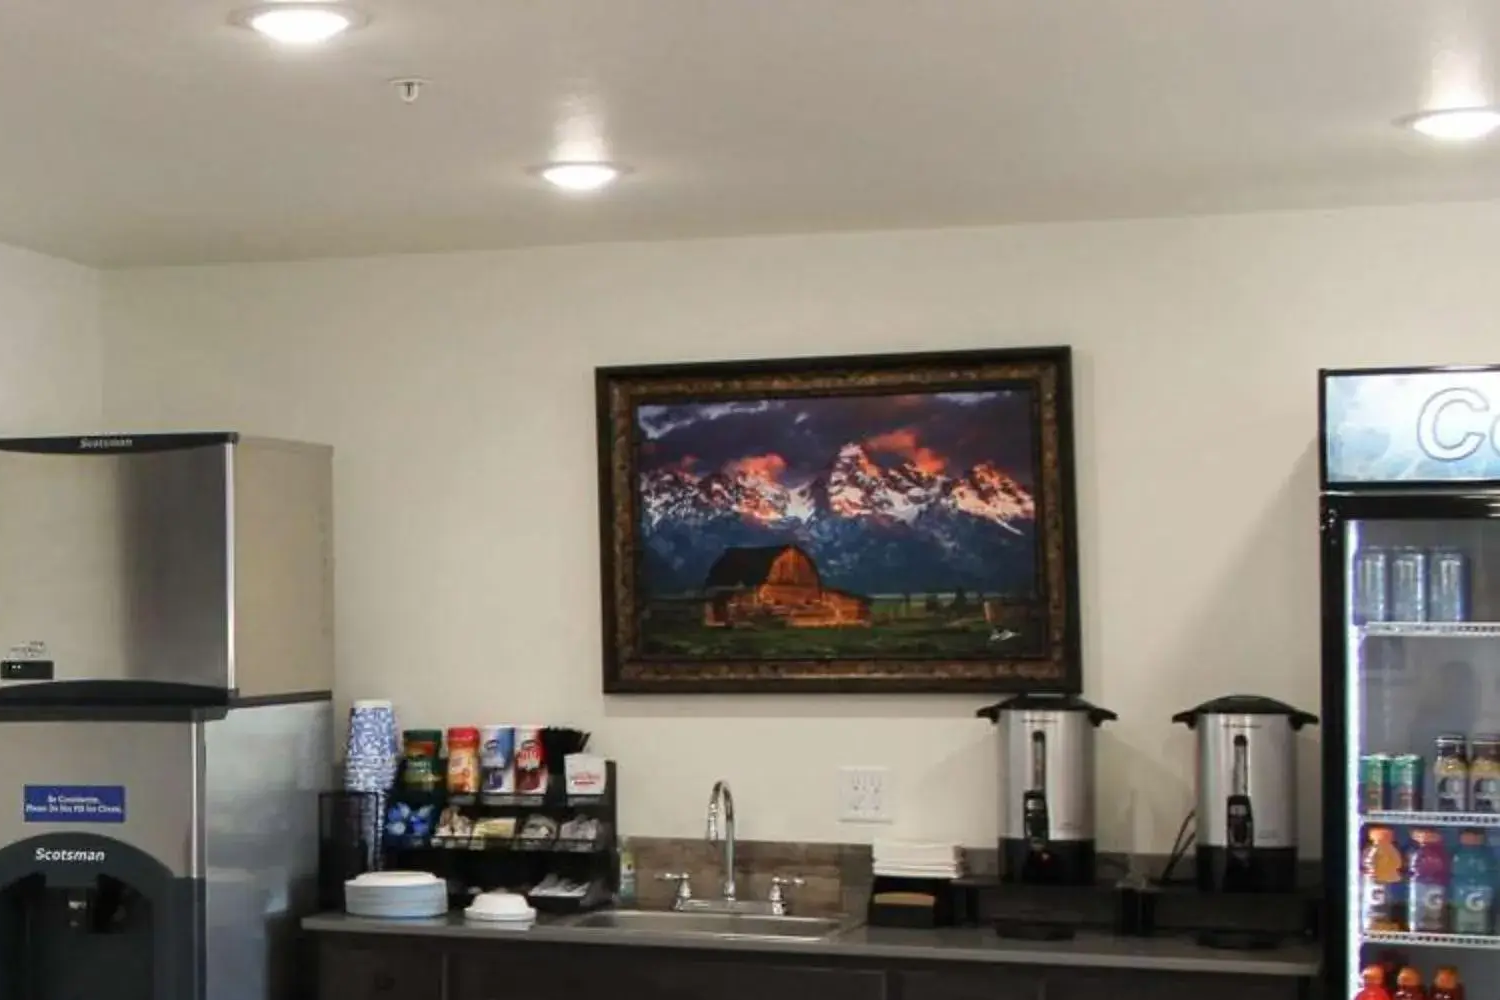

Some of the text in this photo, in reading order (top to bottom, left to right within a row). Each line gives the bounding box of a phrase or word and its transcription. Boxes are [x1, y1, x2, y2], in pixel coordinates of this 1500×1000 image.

[1417, 387, 1500, 461] C
[35, 847, 105, 861] Scotsman
[1466, 891, 1485, 911] G
